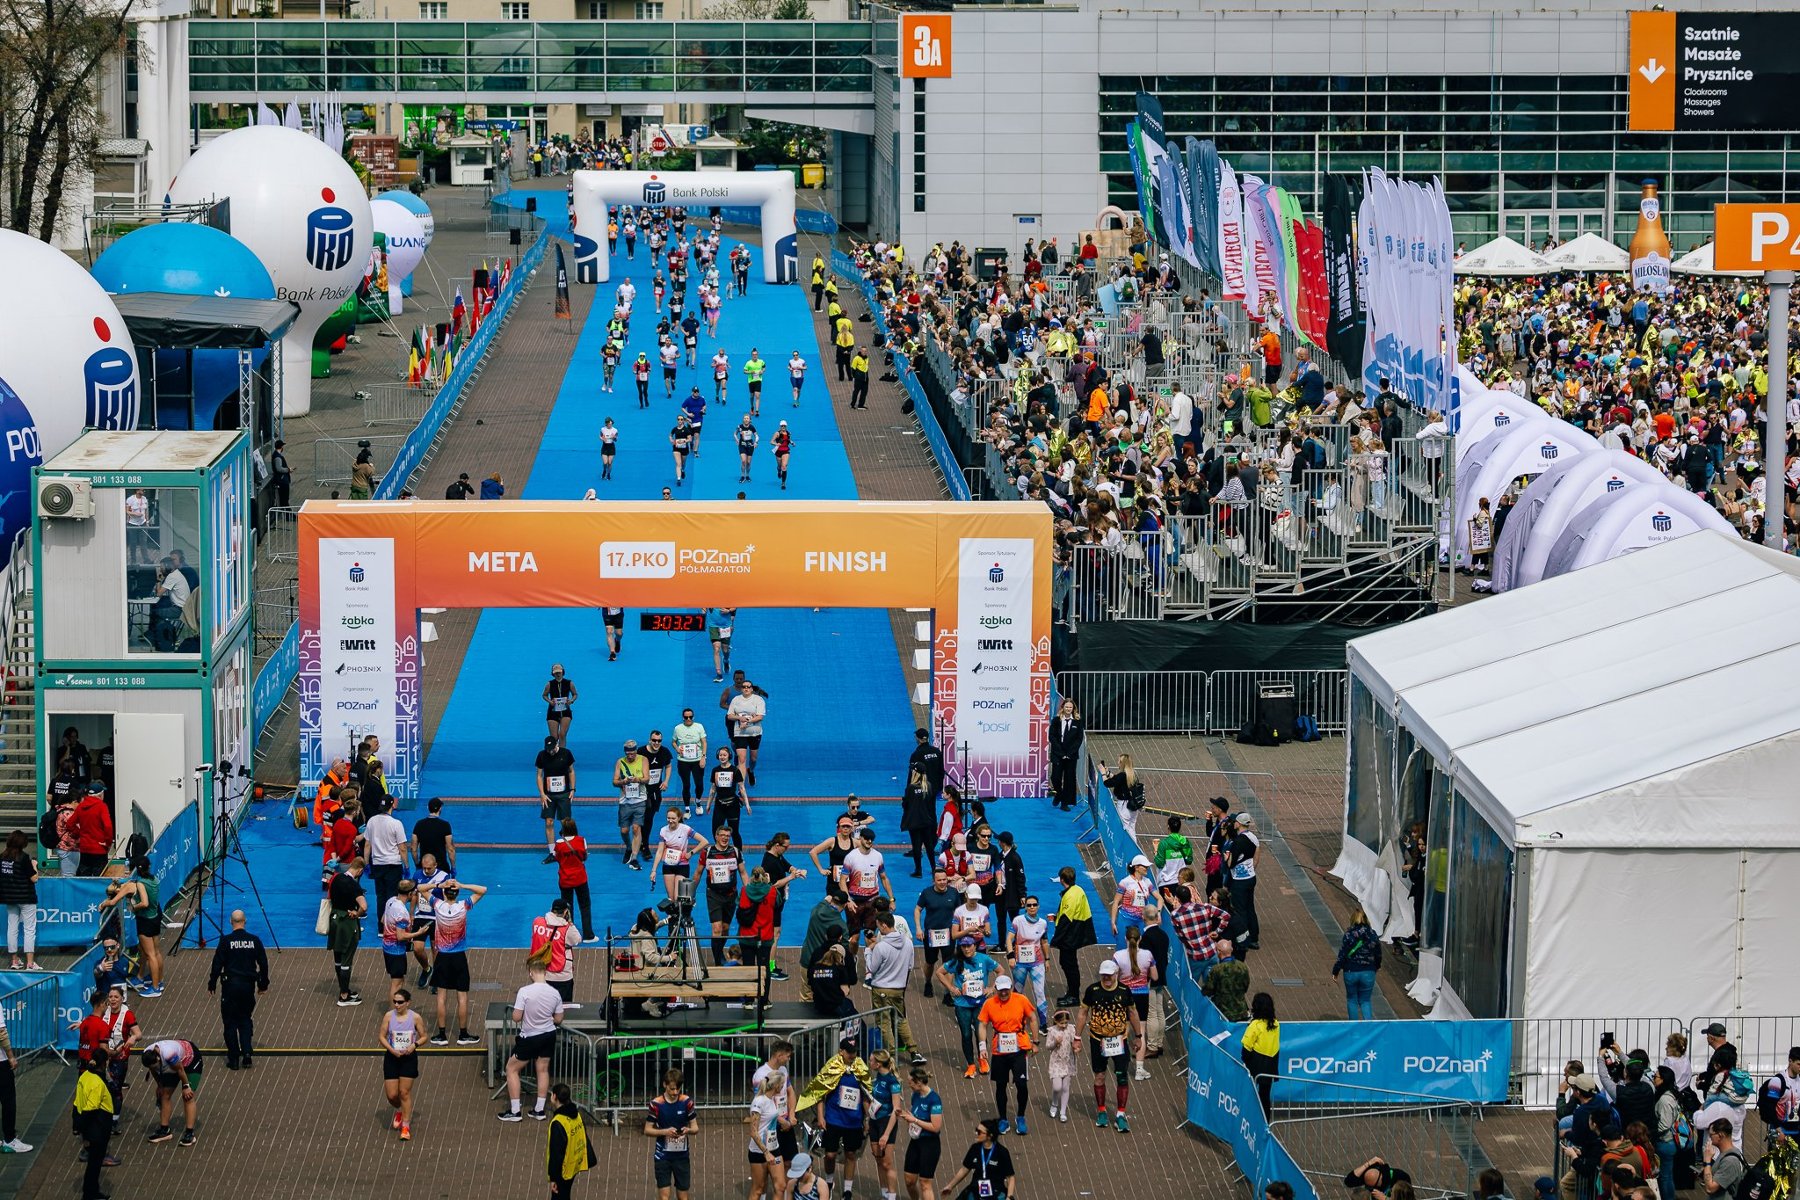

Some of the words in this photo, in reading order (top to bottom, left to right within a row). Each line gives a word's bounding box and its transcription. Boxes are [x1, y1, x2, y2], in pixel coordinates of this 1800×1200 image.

[1684, 26, 1740, 41] Szatnie
[914, 25, 942, 67] 3A
[1684, 47, 1741, 61] Masaże
[1684, 67, 1753, 84] Prysznice
[1684, 88, 1727, 96] Cloakrooms
[1684, 98, 1721, 107] Massages
[1684, 108, 1714, 116] Showers
[511, 121, 517, 129] 7
[694, 128, 703, 137] C
[673, 187, 697, 198] Bank
[700, 187, 729, 198] Polski
[1752, 212, 1800, 262] P
[277, 286, 316, 301] Bank
[320, 285, 353, 301] Polski
[93, 476, 107, 484] 801
[111, 476, 125, 484] 133
[127, 476, 142, 484] 088
[468, 551, 538, 573] META
[804, 551, 887, 573] FINISH
[679, 565, 751, 574] PÓŁMARATON
[342, 615, 375, 625] żabka
[980, 615, 1012, 625] żabka
[97, 677, 110, 685] 801
[114, 677, 128, 685] 133
[131, 677, 146, 685] 088
[982, 721, 1011, 734] posir
[533, 925, 561, 940] FOTO
[230, 940, 255, 949] POLICJA
